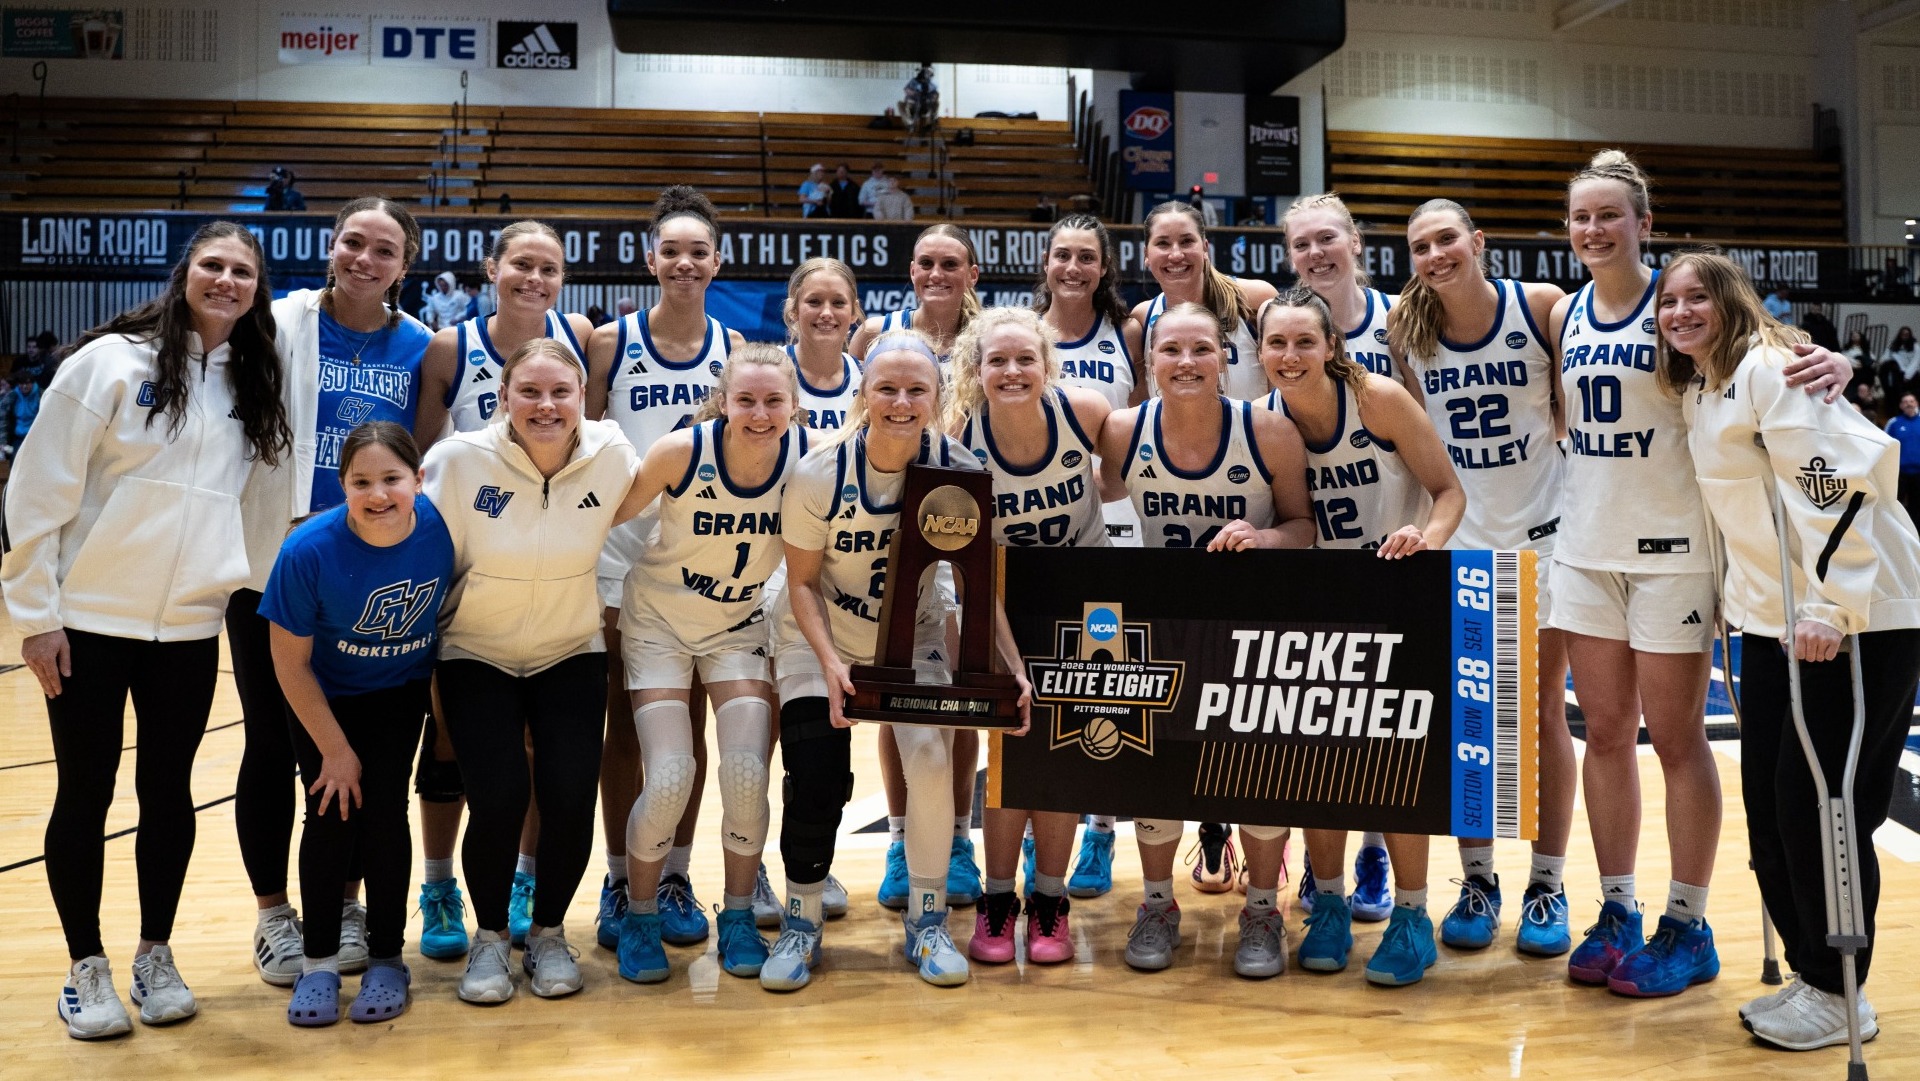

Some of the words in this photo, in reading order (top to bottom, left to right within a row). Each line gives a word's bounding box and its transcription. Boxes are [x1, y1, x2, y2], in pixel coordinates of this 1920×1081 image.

[281, 26, 359, 55] meijer
[382, 26, 476, 60] DTE
[503, 51, 571, 68] adidas
[1133, 114, 1164, 133] DQ
[22, 217, 91, 255] LONG
[99, 218, 168, 257] ROAD
[564, 230, 601, 264] OF
[721, 232, 890, 267] ATHLETICS
[968, 229, 1000, 265] NG
[48, 255, 141, 266] DISTILLERS
[1768, 249, 1819, 282] ROAD
[864, 289, 919, 311] NCA
[1060, 359, 1115, 385] AND
[1562, 343, 1656, 374] GRAND
[350, 367, 411, 410] LAKERS
[1424, 360, 1529, 395] GRAND
[337, 396, 376, 426] GV
[630, 383, 712, 412] GRAN
[1577, 375, 1622, 423] 10
[1445, 393, 1511, 439] 22
[1568, 426, 1655, 458] VALLEY
[1305, 458, 1380, 492] RAND
[473, 485, 515, 518] GV
[1142, 490, 1247, 521] GRAND
[693, 510, 782, 536] GRAN
[923, 514, 978, 537] NCAA
[1003, 513, 1071, 547] 20
[1313, 496, 1364, 542] 12
[731, 541, 751, 579] 1
[681, 566, 765, 603] VALLE
[1457, 565, 1490, 612] 26
[351, 576, 440, 640] GV
[1089, 623, 1118, 634] NCAA
[1463, 618, 1483, 652] SEAT
[1060, 661, 1085, 670] 2026
[1086, 663, 1102, 671] DII
[1103, 663, 1145, 673] WOMEN'S
[1231, 629, 1404, 683] TICKET
[1041, 670, 1100, 696] ELITE
[1102, 672, 1170, 699] EIGHT
[1457, 656, 1490, 703] 28
[889, 696, 938, 711] REGIONAL
[939, 699, 990, 713] CHAMPION
[1073, 704, 1131, 715] PITTSBURGH
[1195, 682, 1435, 740] PUNCHED
[1463, 706, 1483, 740] ROW
[1457, 741, 1490, 767] 3
[1463, 768, 1483, 829] SECTION
